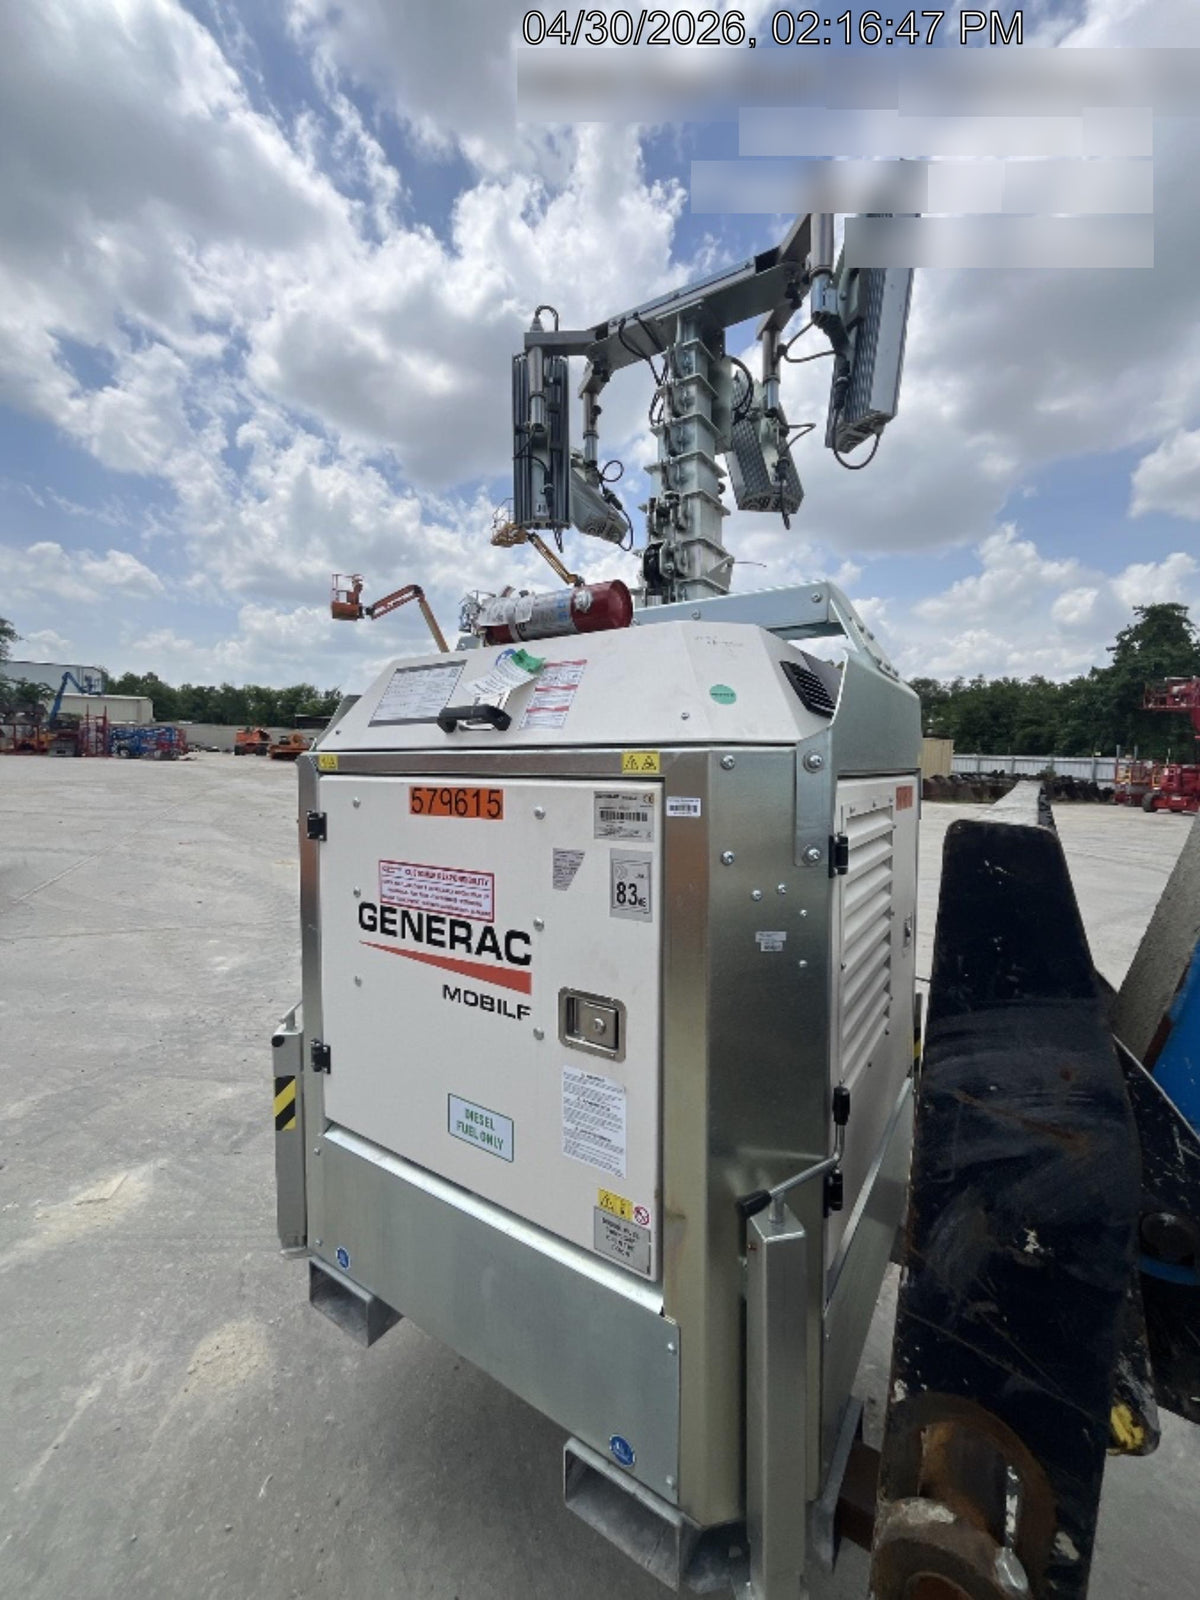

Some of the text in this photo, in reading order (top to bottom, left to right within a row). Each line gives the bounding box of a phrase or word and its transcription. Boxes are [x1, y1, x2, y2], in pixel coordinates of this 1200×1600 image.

[411, 787, 502, 818] 579615
[616, 881, 638, 906] 83
[358, 901, 532, 966] GENERAC
[464, 1107, 496, 1131] DIESEL
[456, 1119, 504, 1151] FUEL ONLY
